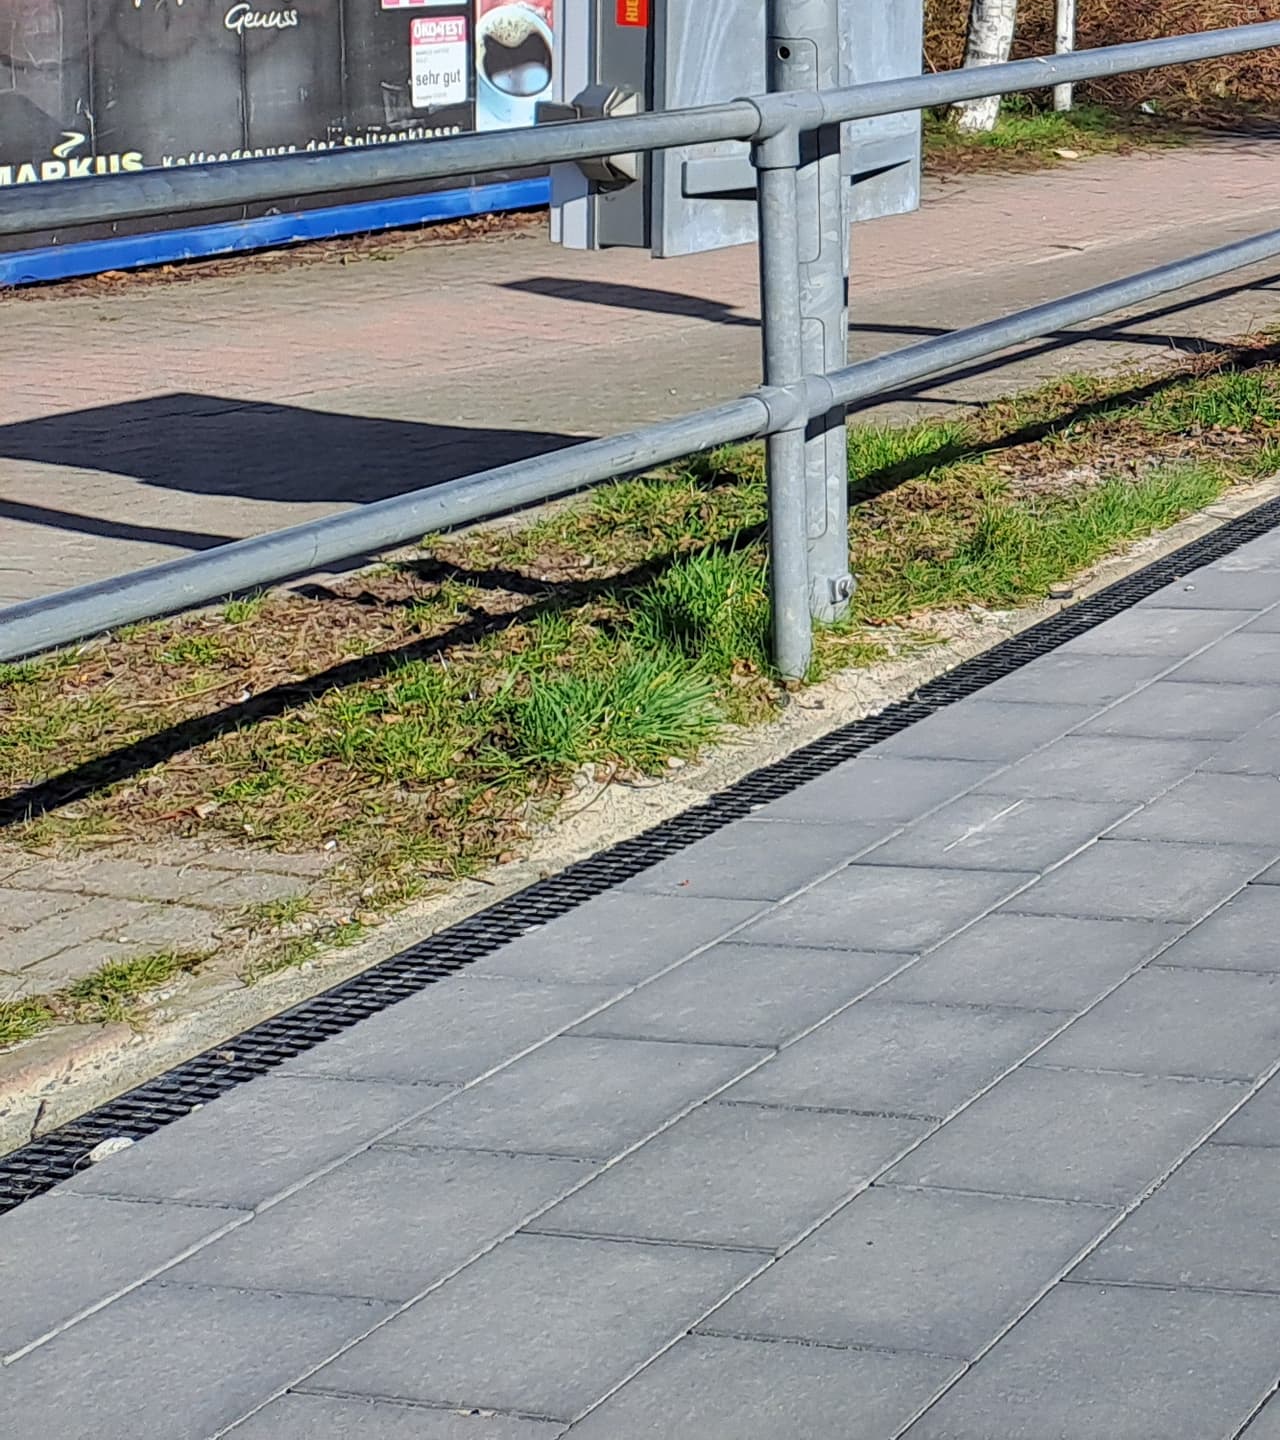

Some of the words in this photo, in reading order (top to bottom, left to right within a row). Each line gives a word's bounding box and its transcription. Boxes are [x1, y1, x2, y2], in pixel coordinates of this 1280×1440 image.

[224, 3, 299, 35] Genuss
[415, 69, 440, 87] sehr
[442, 68, 462, 88] gut
